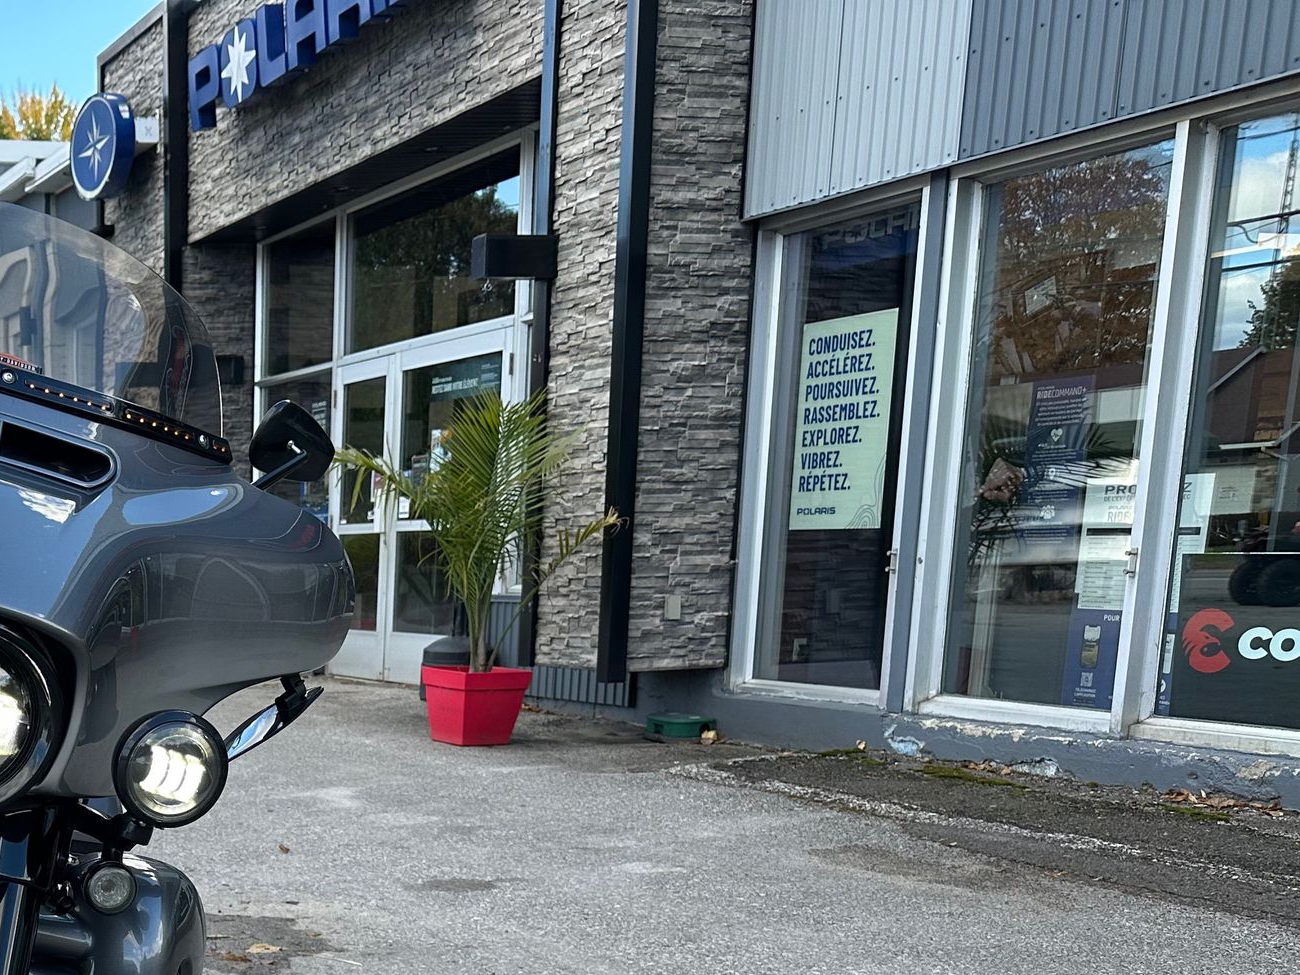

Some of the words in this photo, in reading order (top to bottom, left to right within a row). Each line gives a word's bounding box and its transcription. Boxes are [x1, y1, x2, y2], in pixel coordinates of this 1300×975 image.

[188, 0, 398, 132] POLA
[808, 329, 876, 356] CONDUISEZ.
[806, 352, 875, 380] ACCÉLÉREZ.
[805, 376, 879, 402] POURSUIVEZ.
[803, 400, 880, 425] RASSEMBLEZ.
[802, 426, 862, 448] EXPLOREZ.
[801, 450, 842, 470] VIBREZ.
[798, 470, 851, 492] RÉPÉTEZ.
[797, 506, 836, 516] POLARIS
